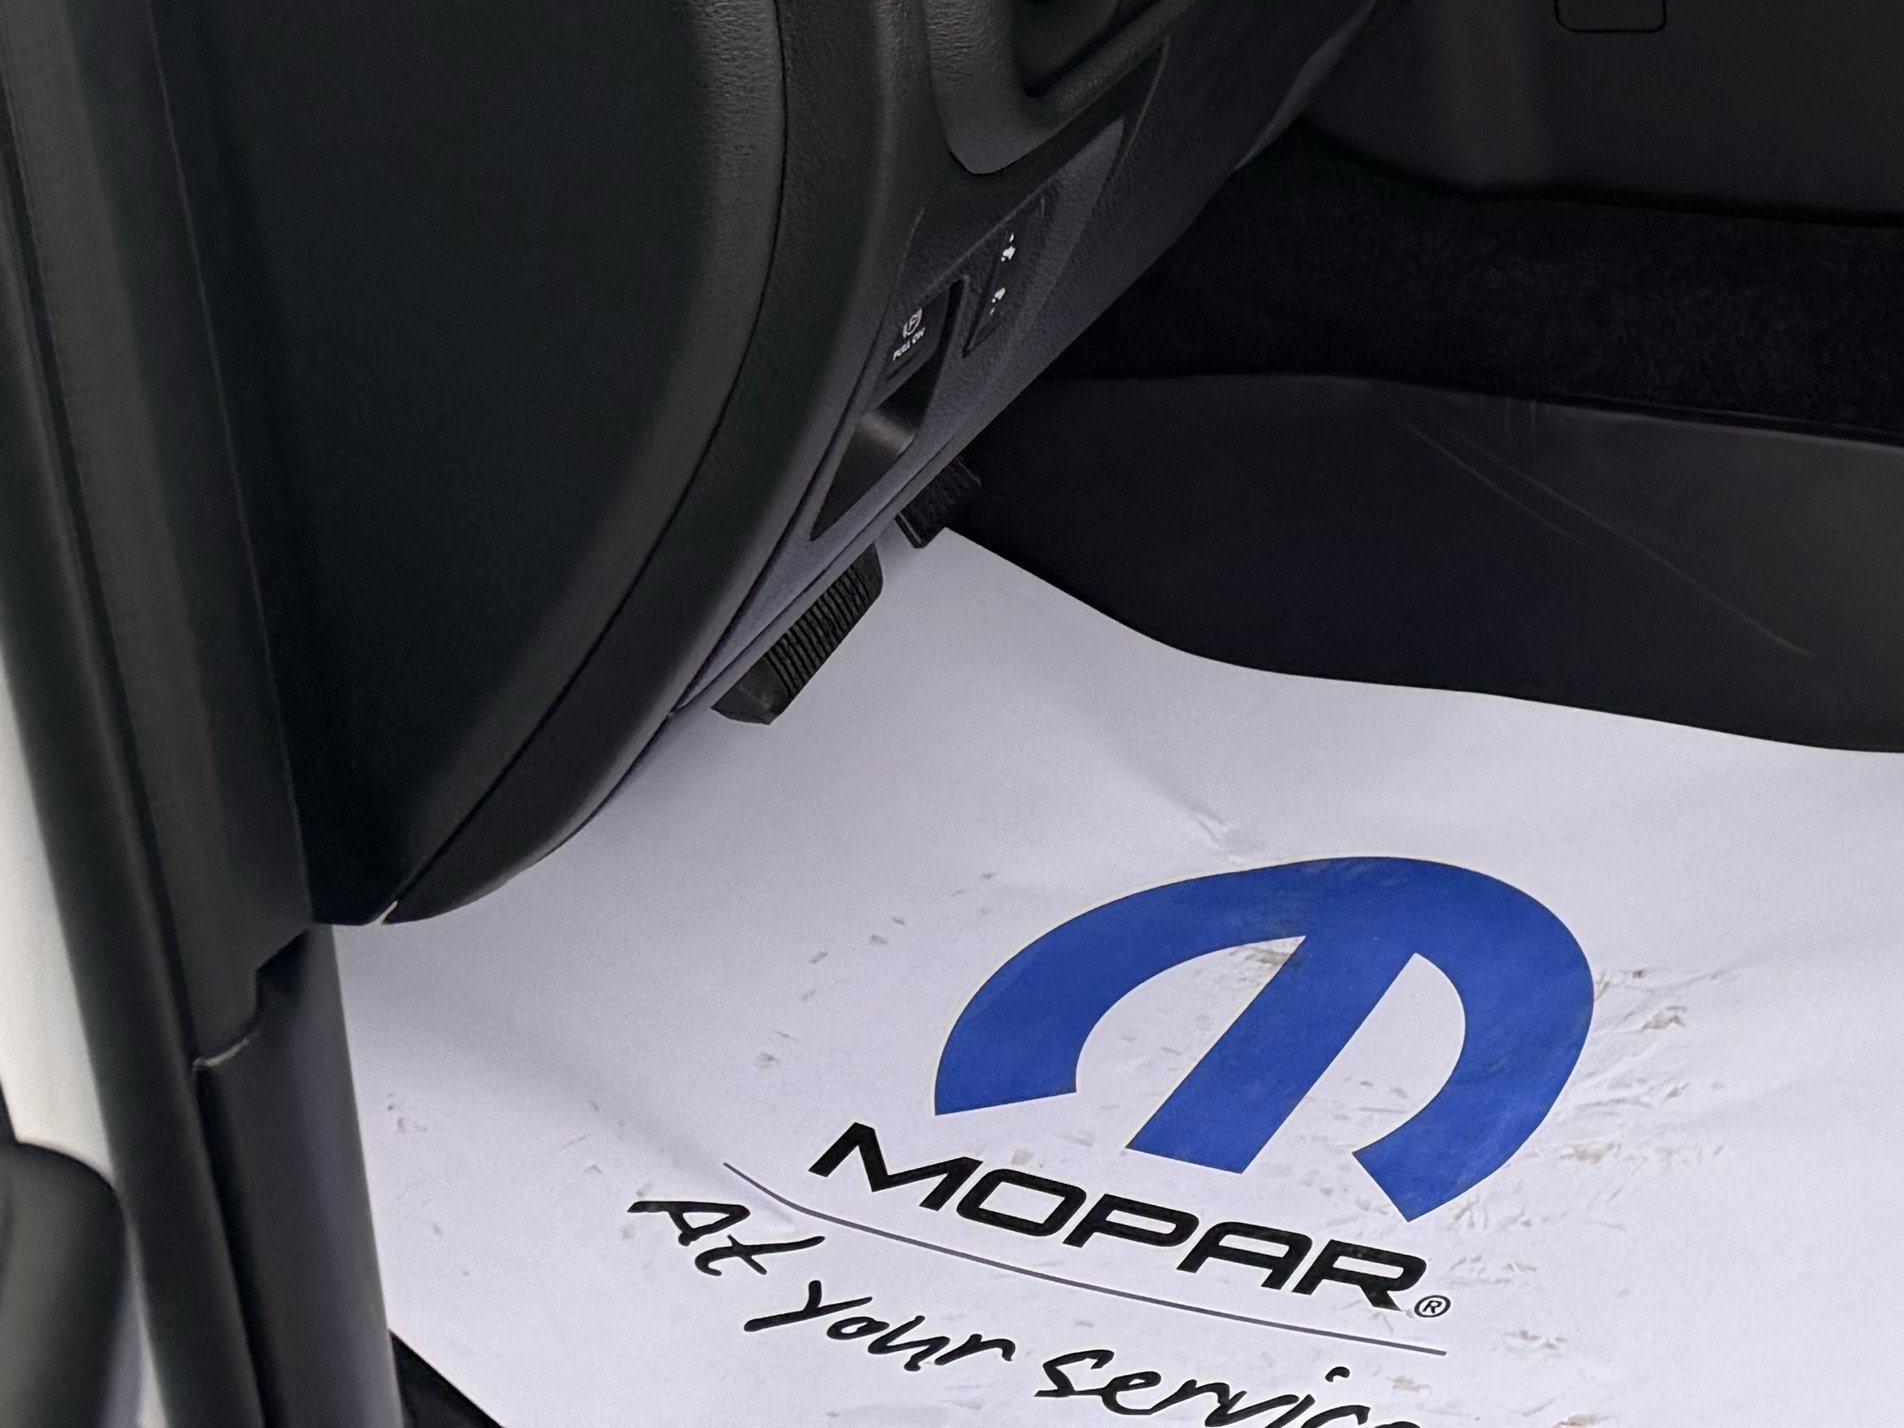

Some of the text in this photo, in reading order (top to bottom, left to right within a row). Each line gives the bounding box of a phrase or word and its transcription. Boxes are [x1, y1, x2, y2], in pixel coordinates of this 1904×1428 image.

[628, 1200, 1420, 1428] At your servic
